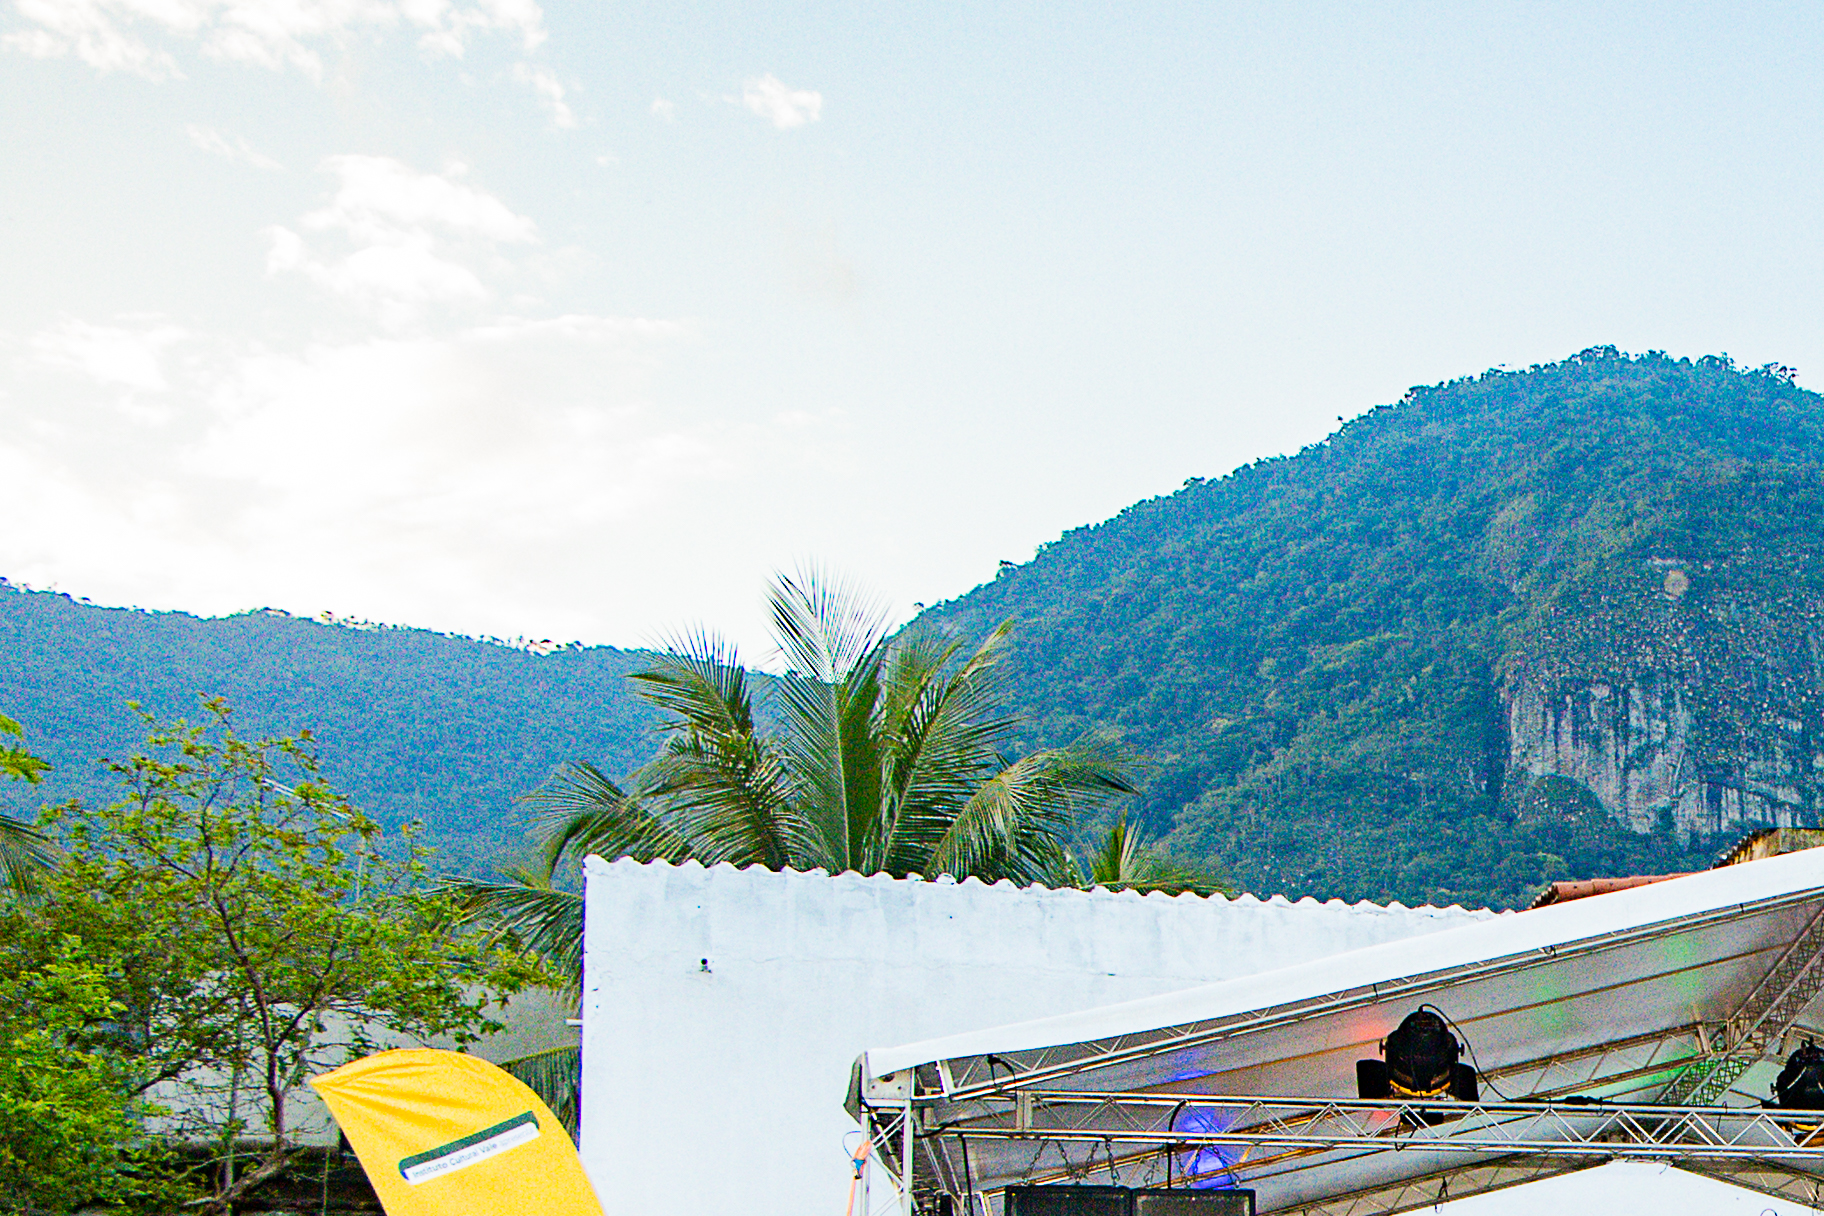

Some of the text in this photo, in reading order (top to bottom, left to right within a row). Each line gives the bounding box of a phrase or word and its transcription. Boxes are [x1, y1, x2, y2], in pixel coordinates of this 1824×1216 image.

[412, 1161, 448, 1178] Instituto
[449, 1149, 479, 1166] Cultural
[479, 1142, 498, 1154] Vale
